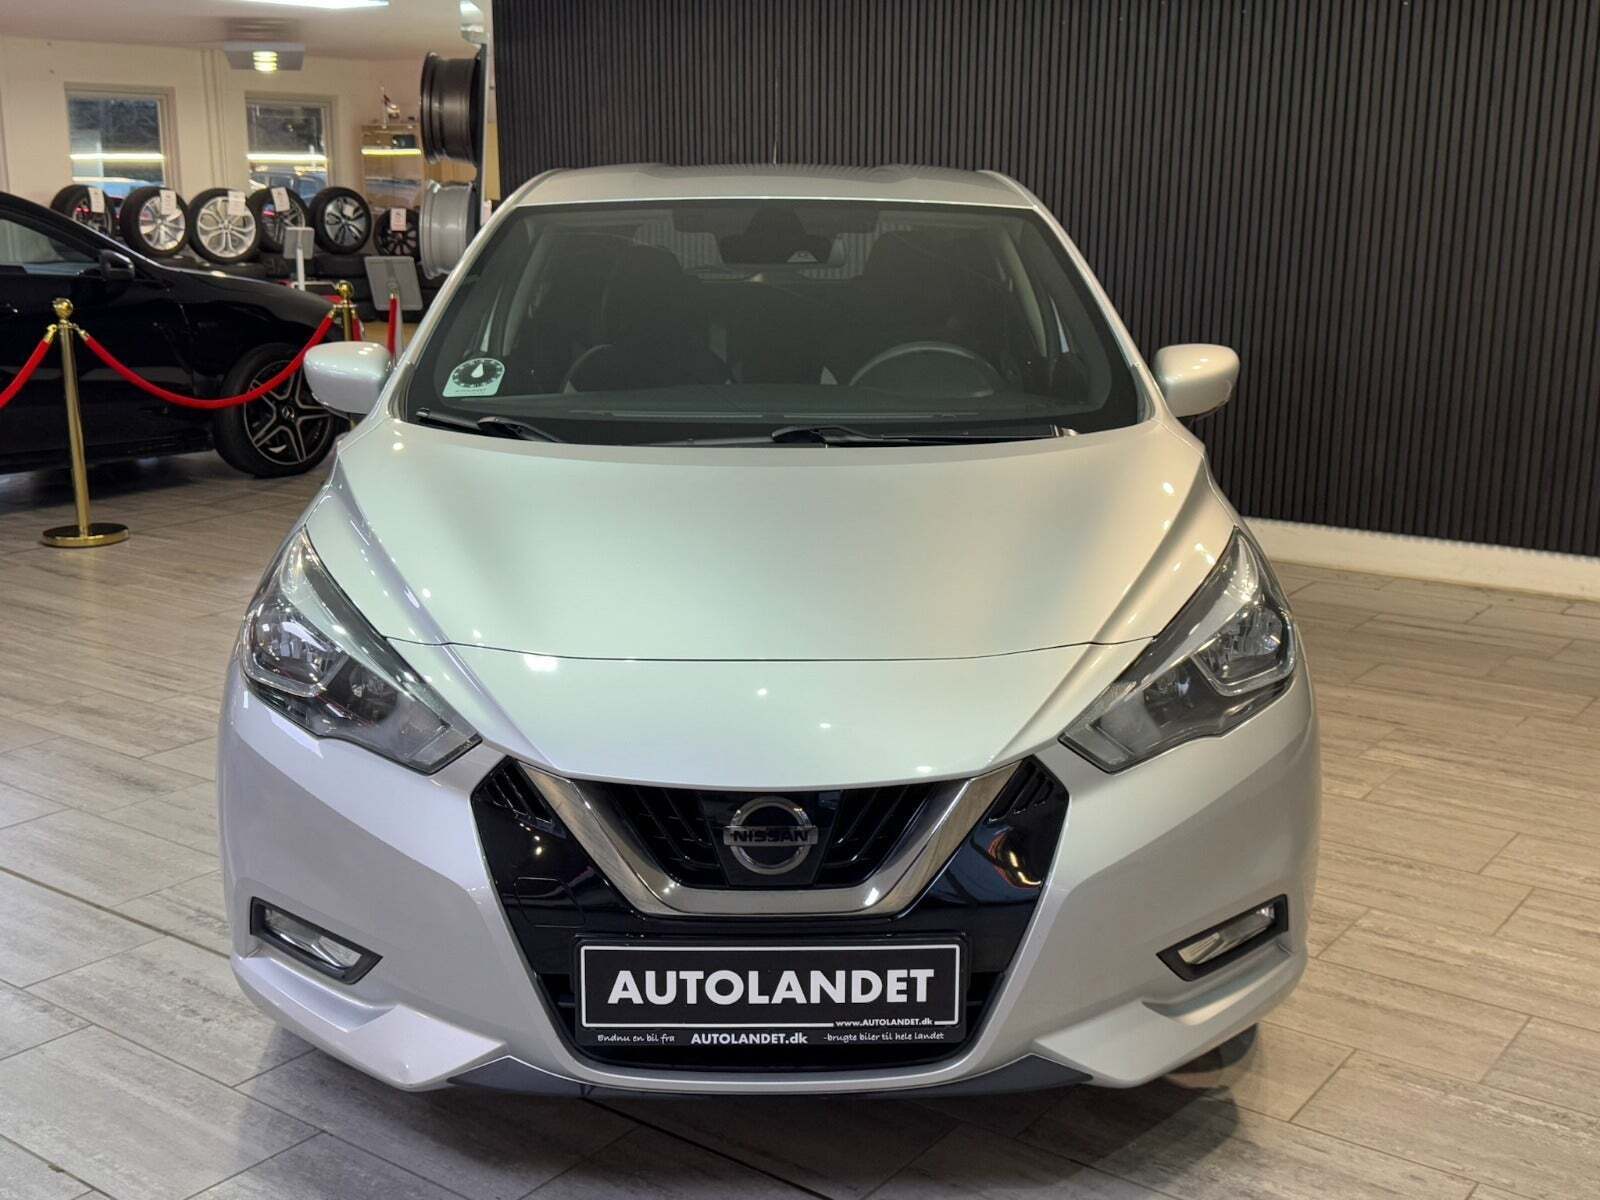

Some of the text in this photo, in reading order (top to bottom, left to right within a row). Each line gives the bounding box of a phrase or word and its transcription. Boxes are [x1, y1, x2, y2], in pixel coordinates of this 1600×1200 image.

[733, 830, 809, 842] NISSAN
[607, 968, 935, 1005] AUTOLANDET
[835, 1018, 933, 1027] www.AUTOLANDET.dk
[647, 1033, 659, 1041] bil
[660, 1034, 675, 1043] fra
[691, 1032, 808, 1045] AUTOLANDET.dk
[824, 1031, 944, 1043] -brugte biler til hele landet
